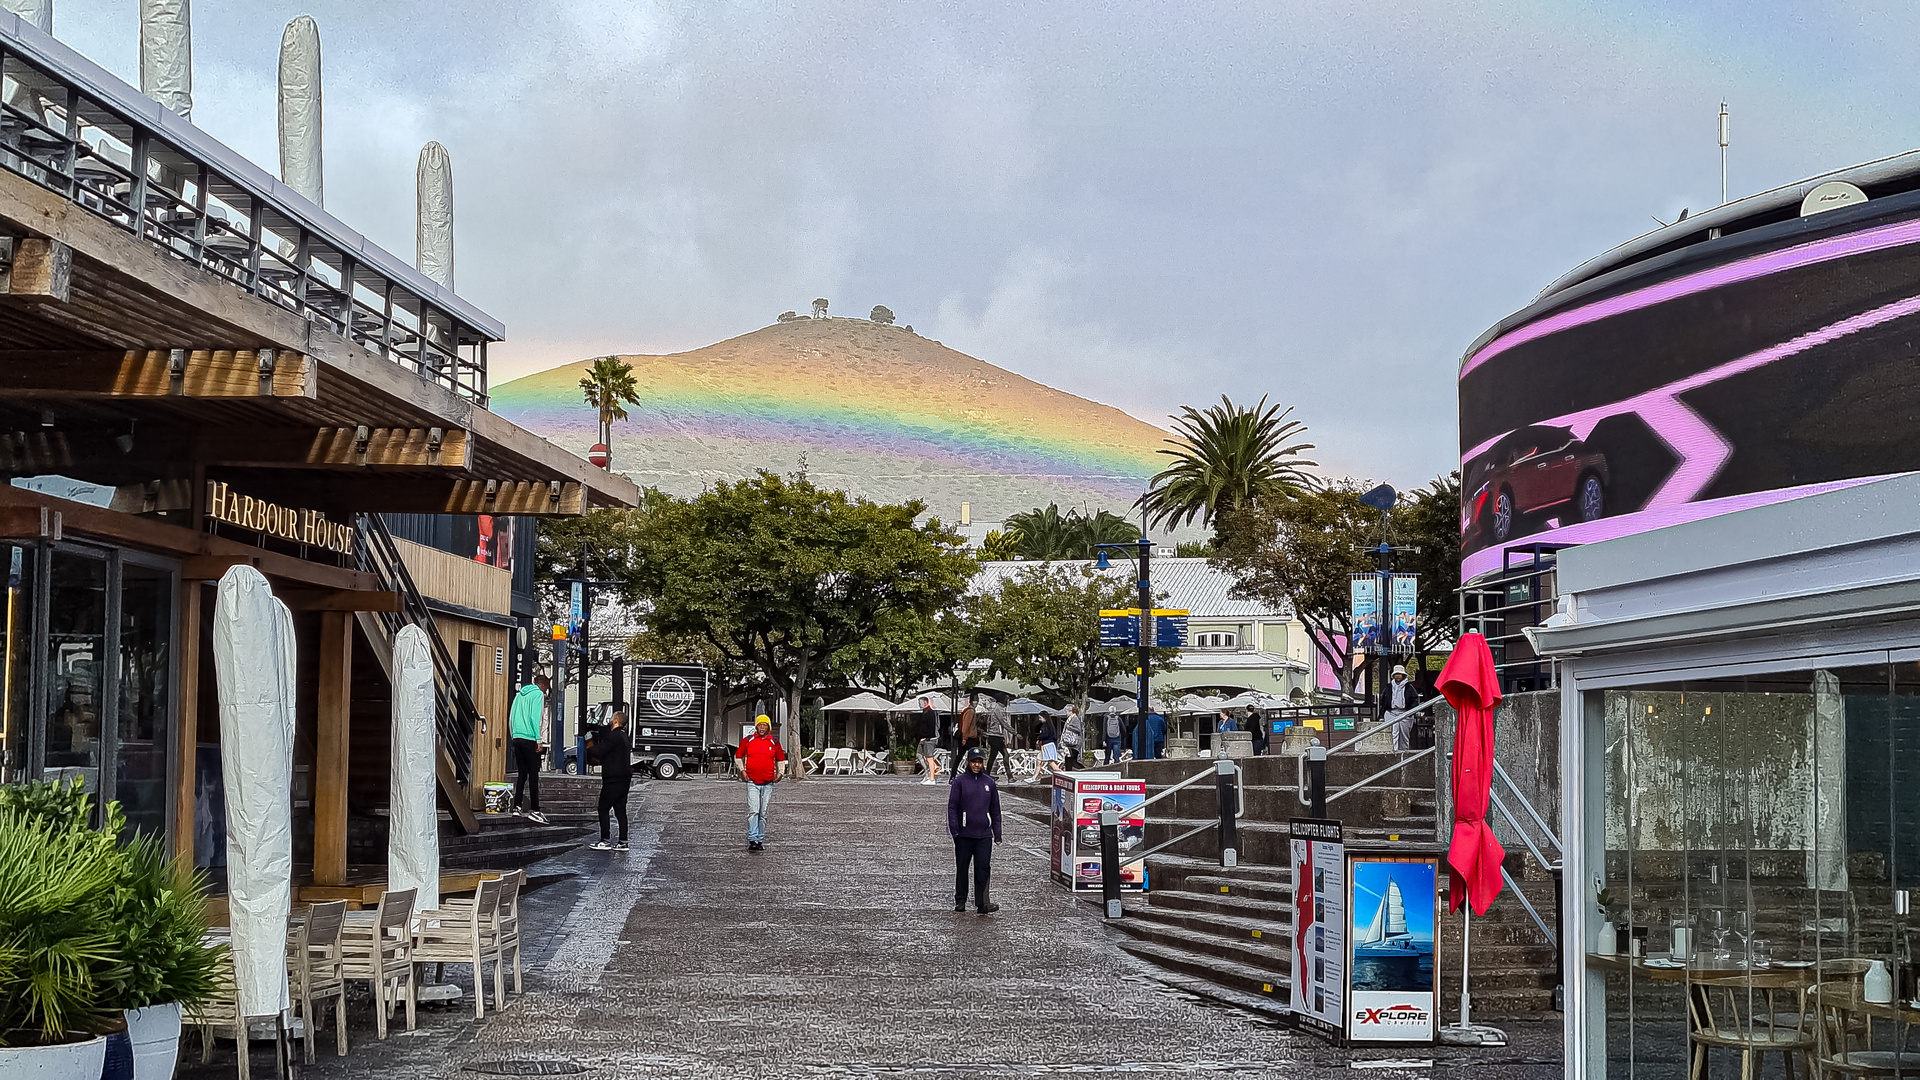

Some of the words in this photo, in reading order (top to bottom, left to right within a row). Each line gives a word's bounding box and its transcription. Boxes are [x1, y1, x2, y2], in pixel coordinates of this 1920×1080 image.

[208, 480, 300, 541] HARBOUR
[302, 508, 354, 556] HOUSE
[649, 692, 693, 700] GOURMAIZE
[1291, 822, 1320, 837] HELICOPTER
[1319, 824, 1340, 839] FLIGHTS
